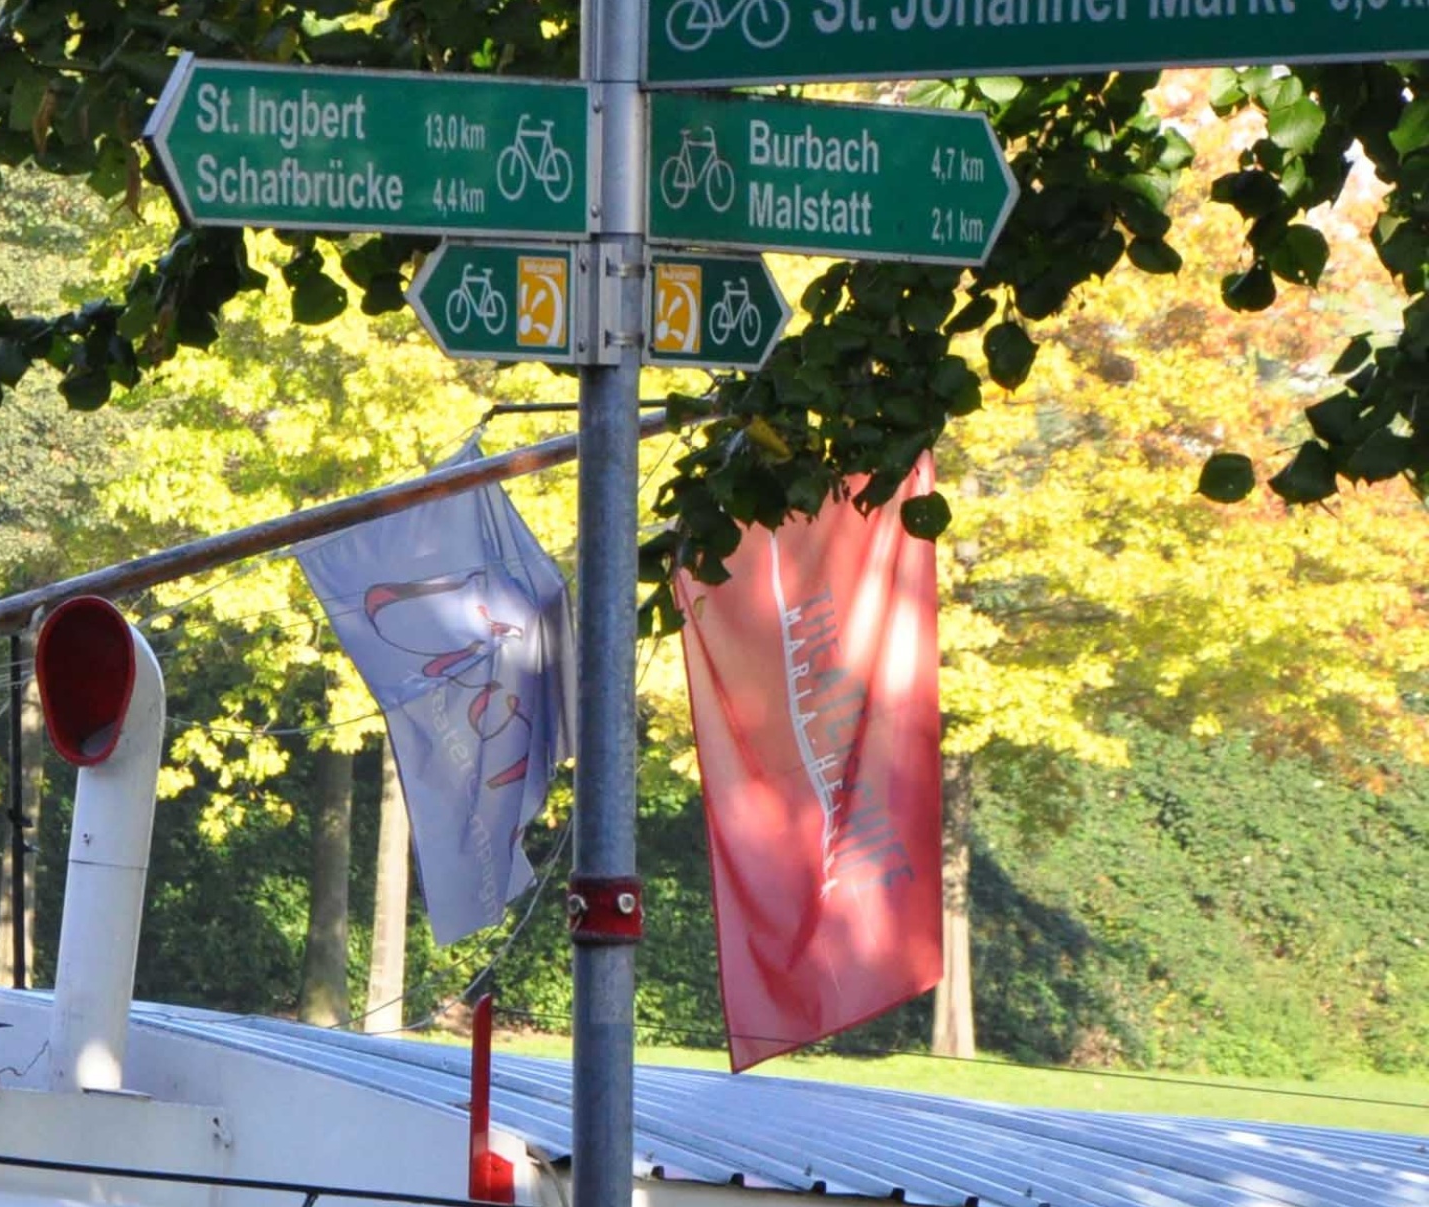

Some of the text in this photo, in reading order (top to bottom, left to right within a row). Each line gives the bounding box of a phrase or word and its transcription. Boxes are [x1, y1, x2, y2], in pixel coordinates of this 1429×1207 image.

[196, 83, 486, 151] St. Ingbert 13,0 km
[749, 119, 984, 184] Burbach 4,7 km
[196, 154, 485, 217] Schafbrücke 4,4 km
[748, 181, 983, 245] Malstatt 2,1 km
